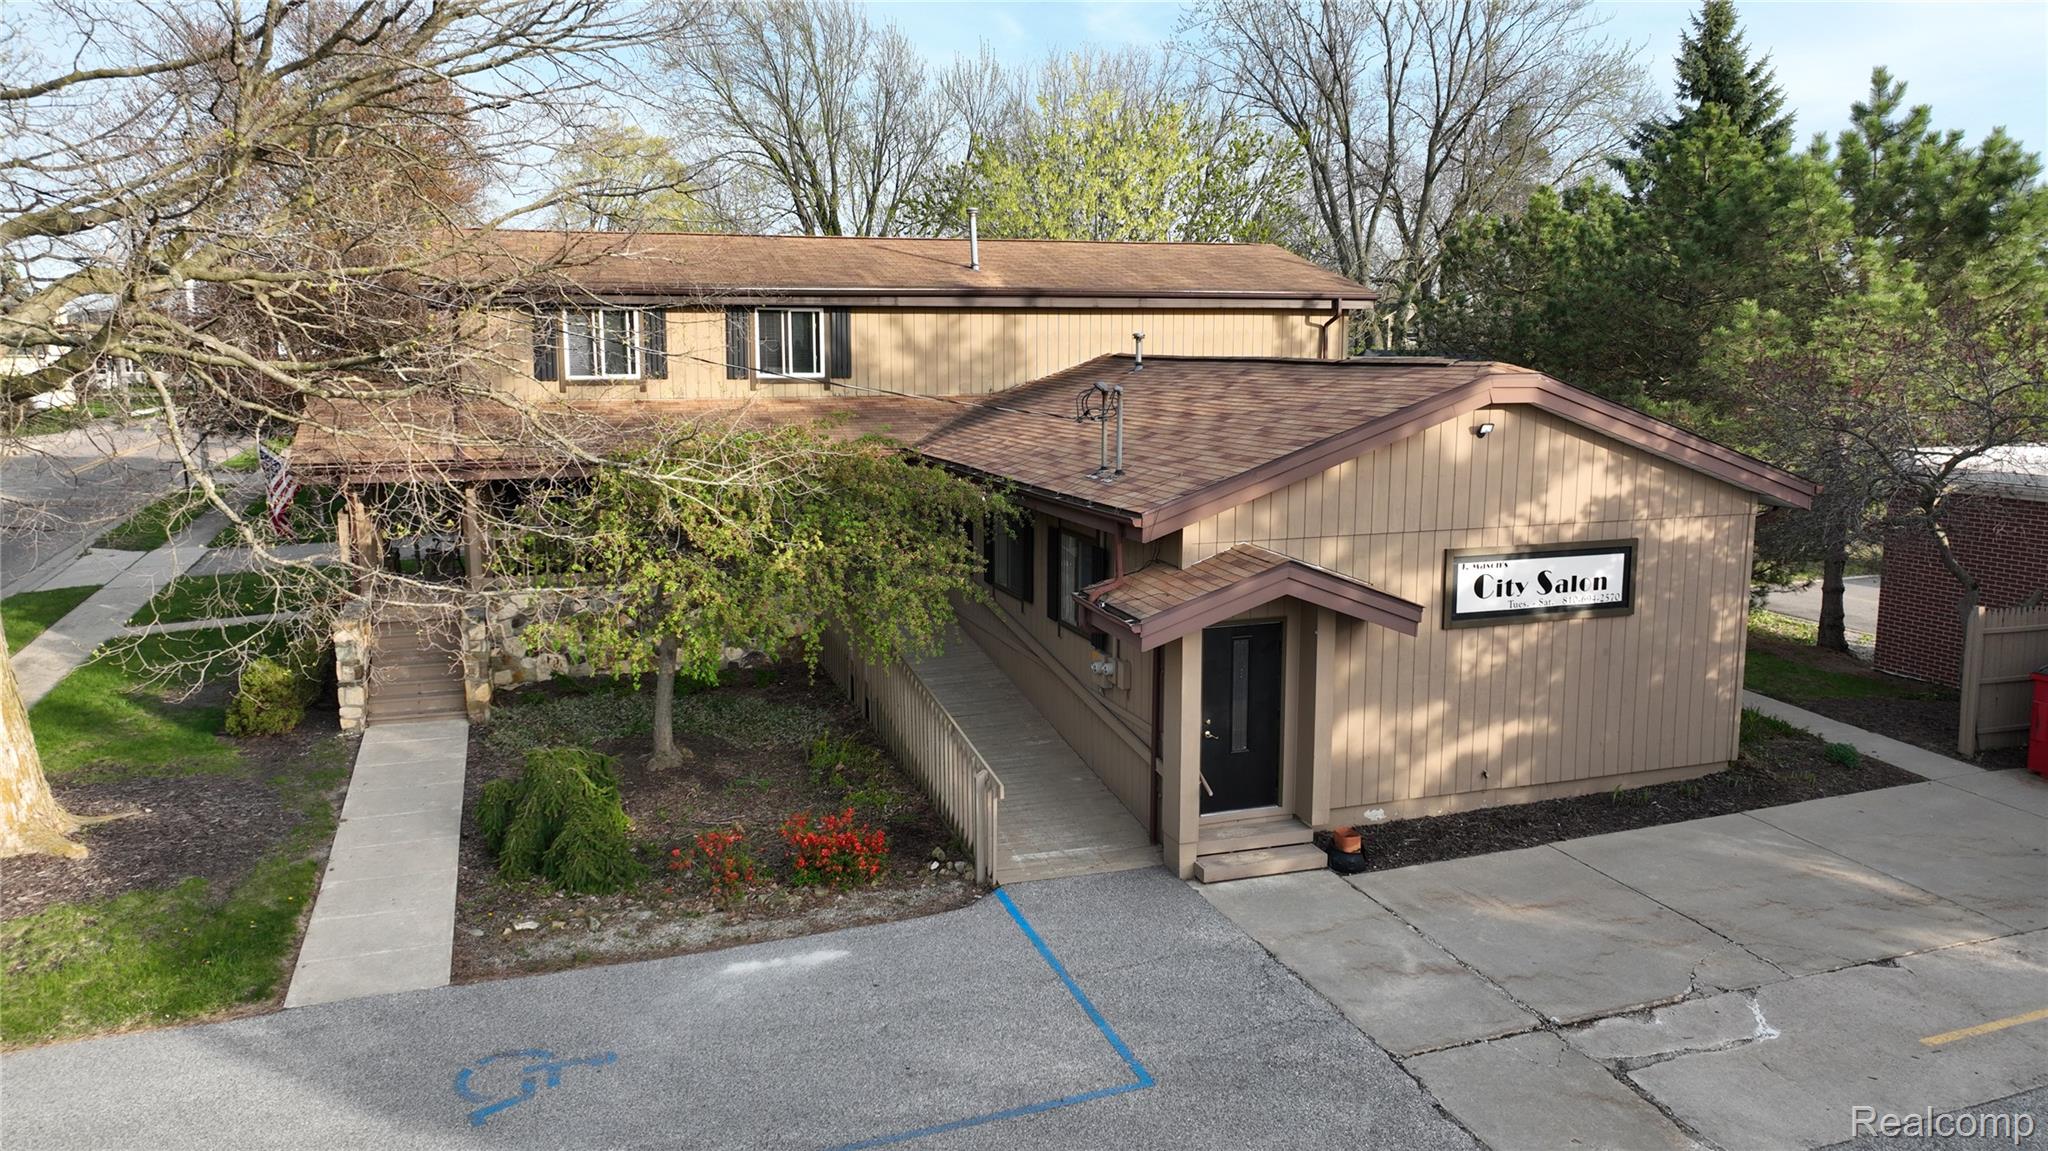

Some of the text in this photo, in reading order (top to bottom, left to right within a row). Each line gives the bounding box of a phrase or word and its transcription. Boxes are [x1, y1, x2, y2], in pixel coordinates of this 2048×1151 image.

[1473, 569, 1608, 600] City Salon
[1508, 599, 1530, 609] Tues.
